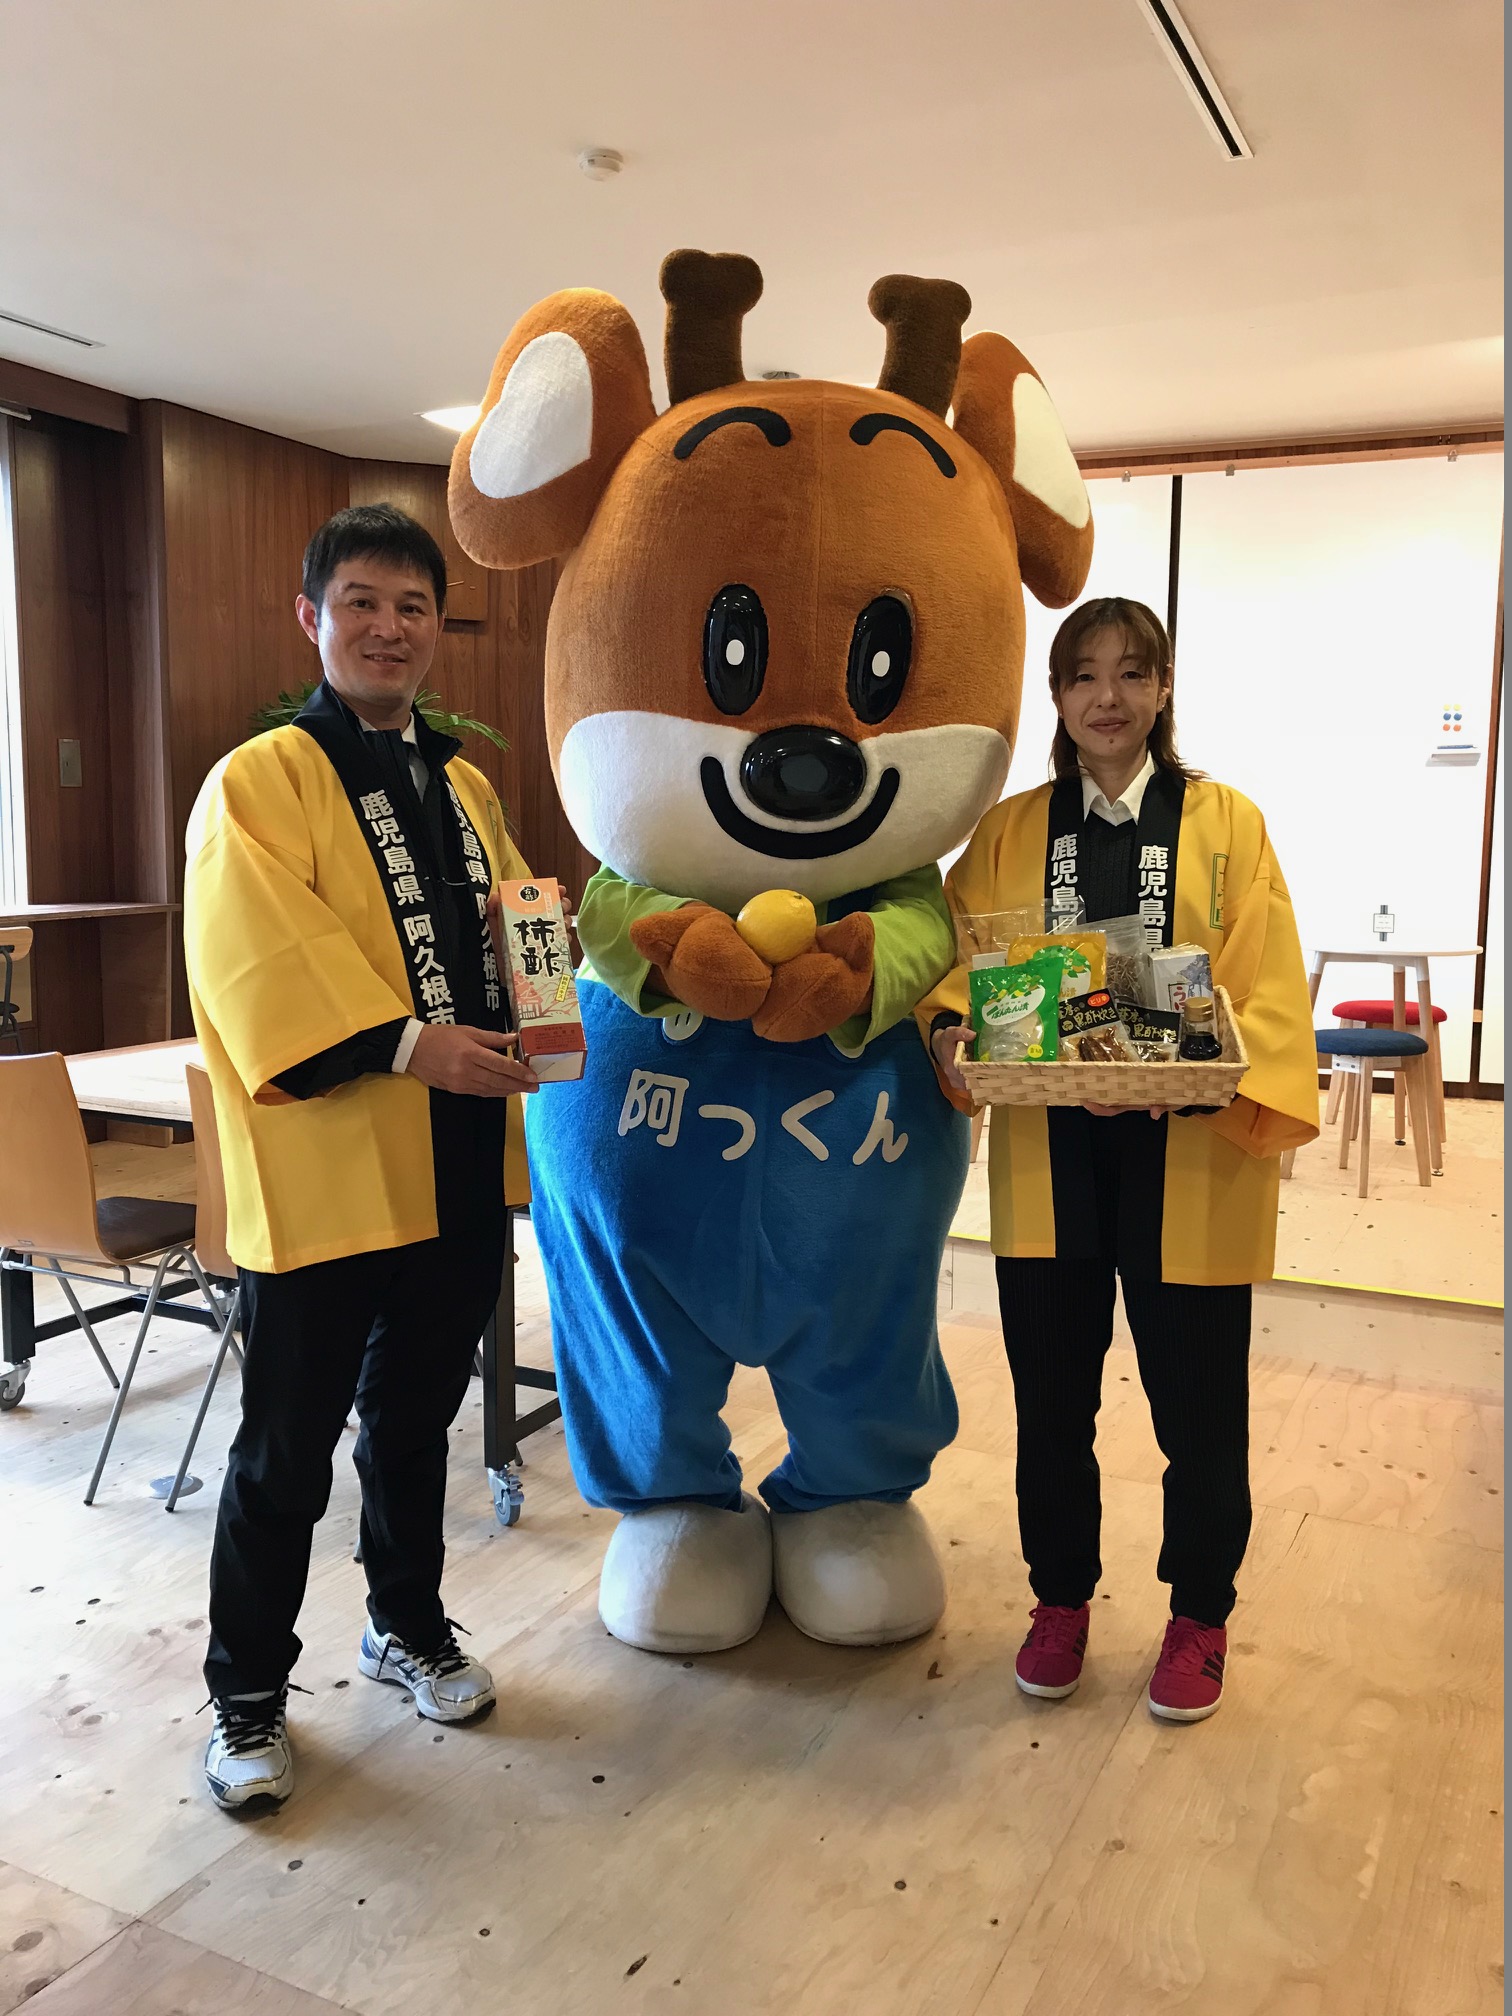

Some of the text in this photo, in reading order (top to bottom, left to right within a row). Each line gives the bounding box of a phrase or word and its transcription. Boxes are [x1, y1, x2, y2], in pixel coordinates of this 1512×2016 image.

[358, 789, 456, 1025] 鹿児島県 阿久根市
[513, 917, 560, 977] 柿酢
[617, 1068, 909, 1166] 阿っくん
